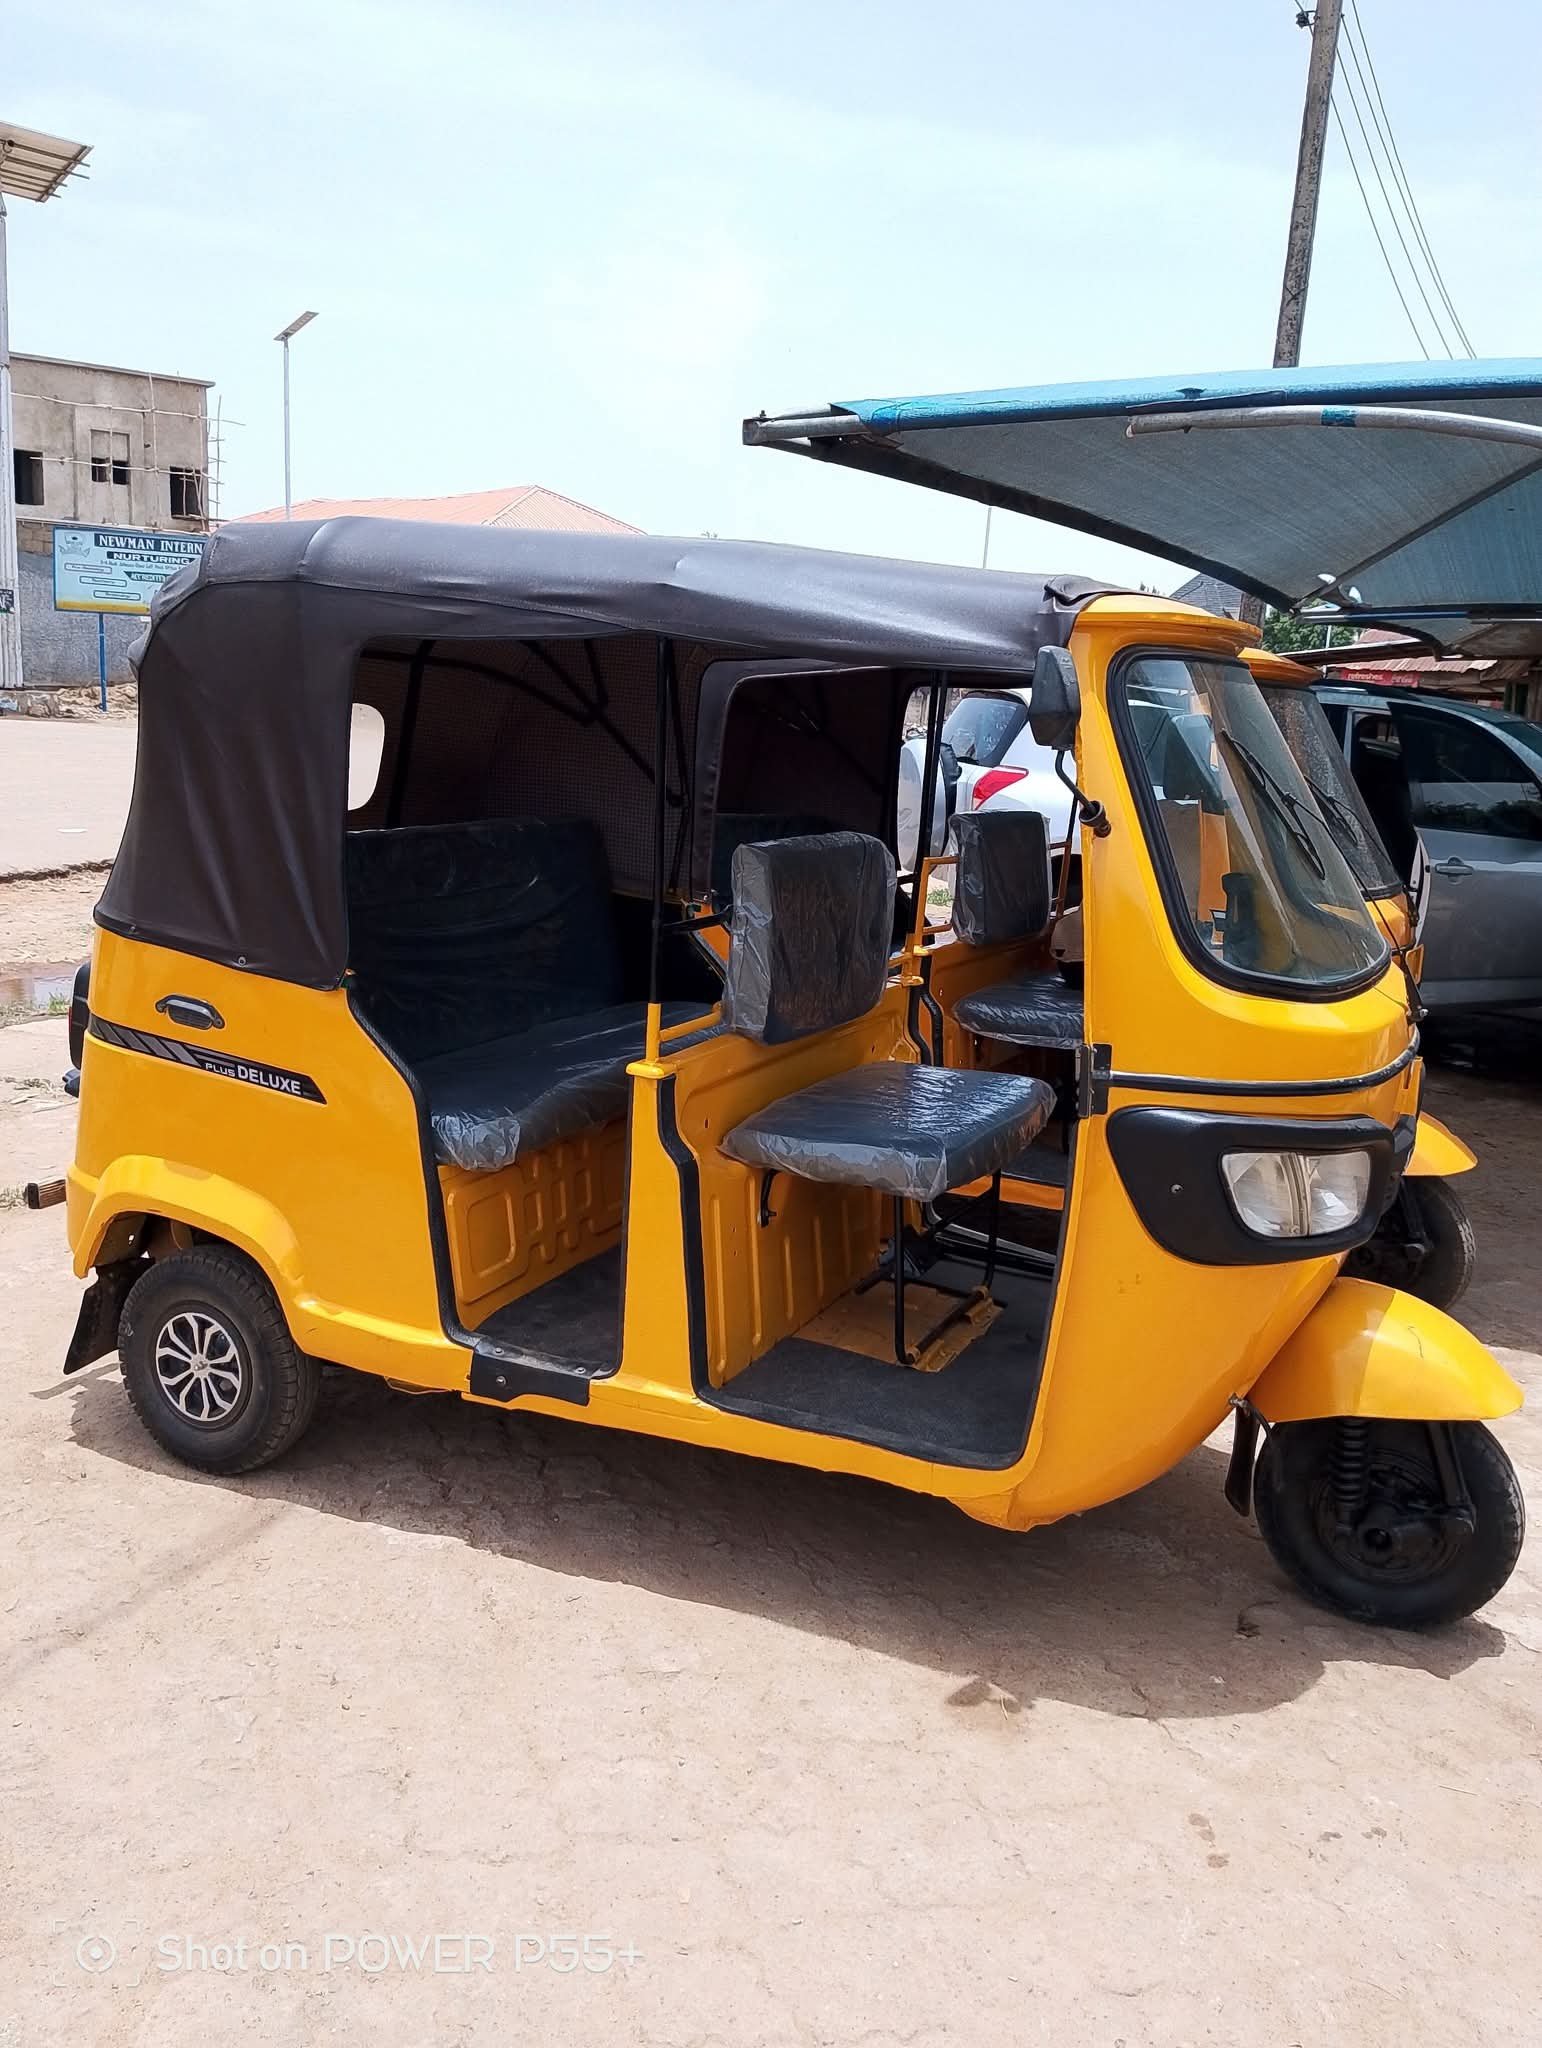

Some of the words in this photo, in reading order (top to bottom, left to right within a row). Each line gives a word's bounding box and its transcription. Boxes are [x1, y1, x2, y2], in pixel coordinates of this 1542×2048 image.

[99, 534, 155, 550] NEWMAN
[113, 553, 190, 565] NURTURING
[205, 1062, 236, 1077] PLUS
[237, 1065, 302, 1095] DELUXE
